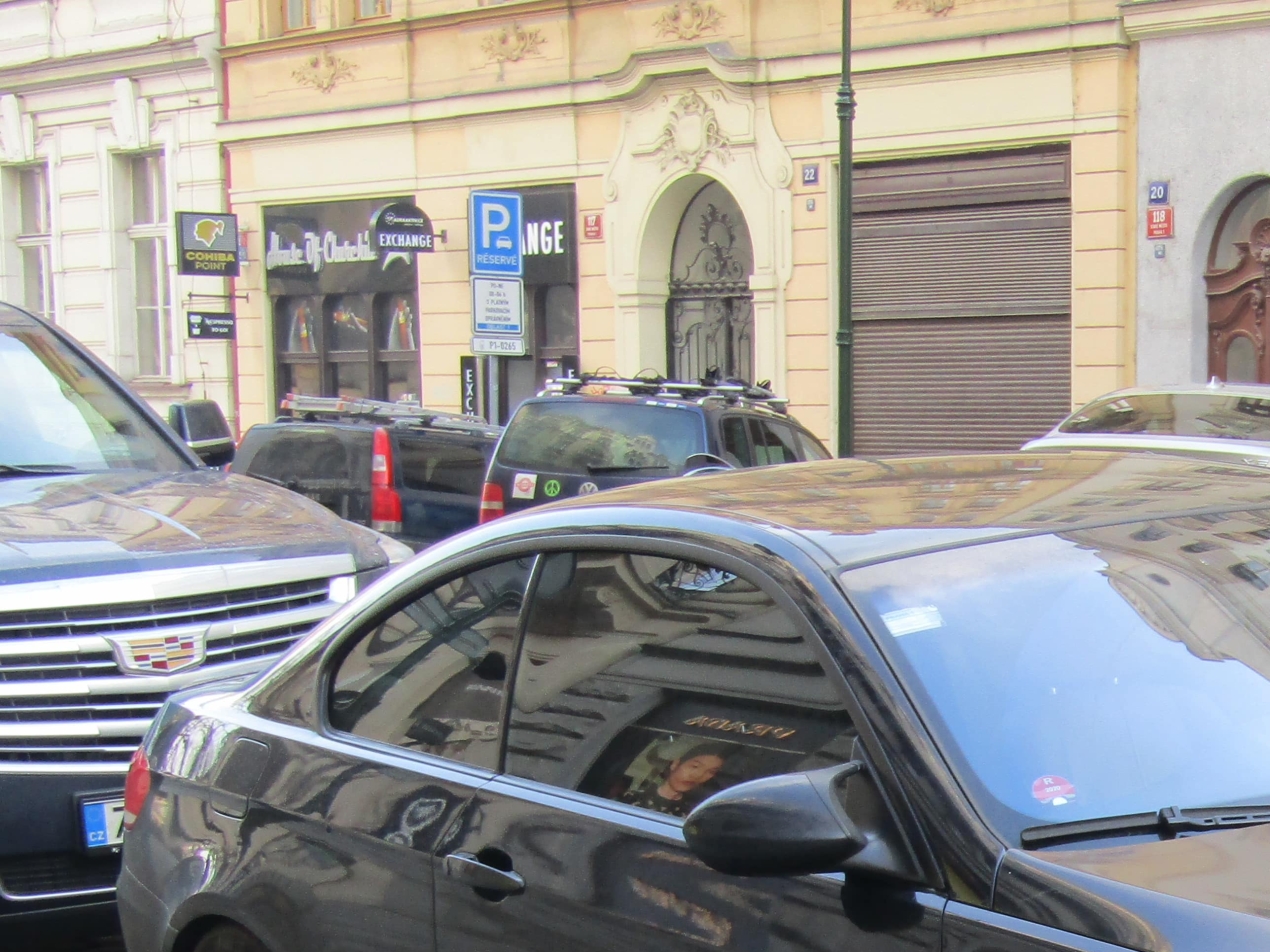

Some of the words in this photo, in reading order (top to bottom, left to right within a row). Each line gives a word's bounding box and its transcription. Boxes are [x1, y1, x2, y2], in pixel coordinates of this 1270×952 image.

[804, 168, 815, 181] 22
[1150, 186, 1164, 199] 20
[1152, 210, 1166, 223] 118
[379, 233, 433, 248] EXCHANGE
[185, 251, 235, 262] COHIBA
[477, 253, 518, 266] RÉSERVÉ
[195, 261, 227, 270] POINT
[489, 341, 516, 351] P1-0265
[90, 831, 105, 842] CZ
